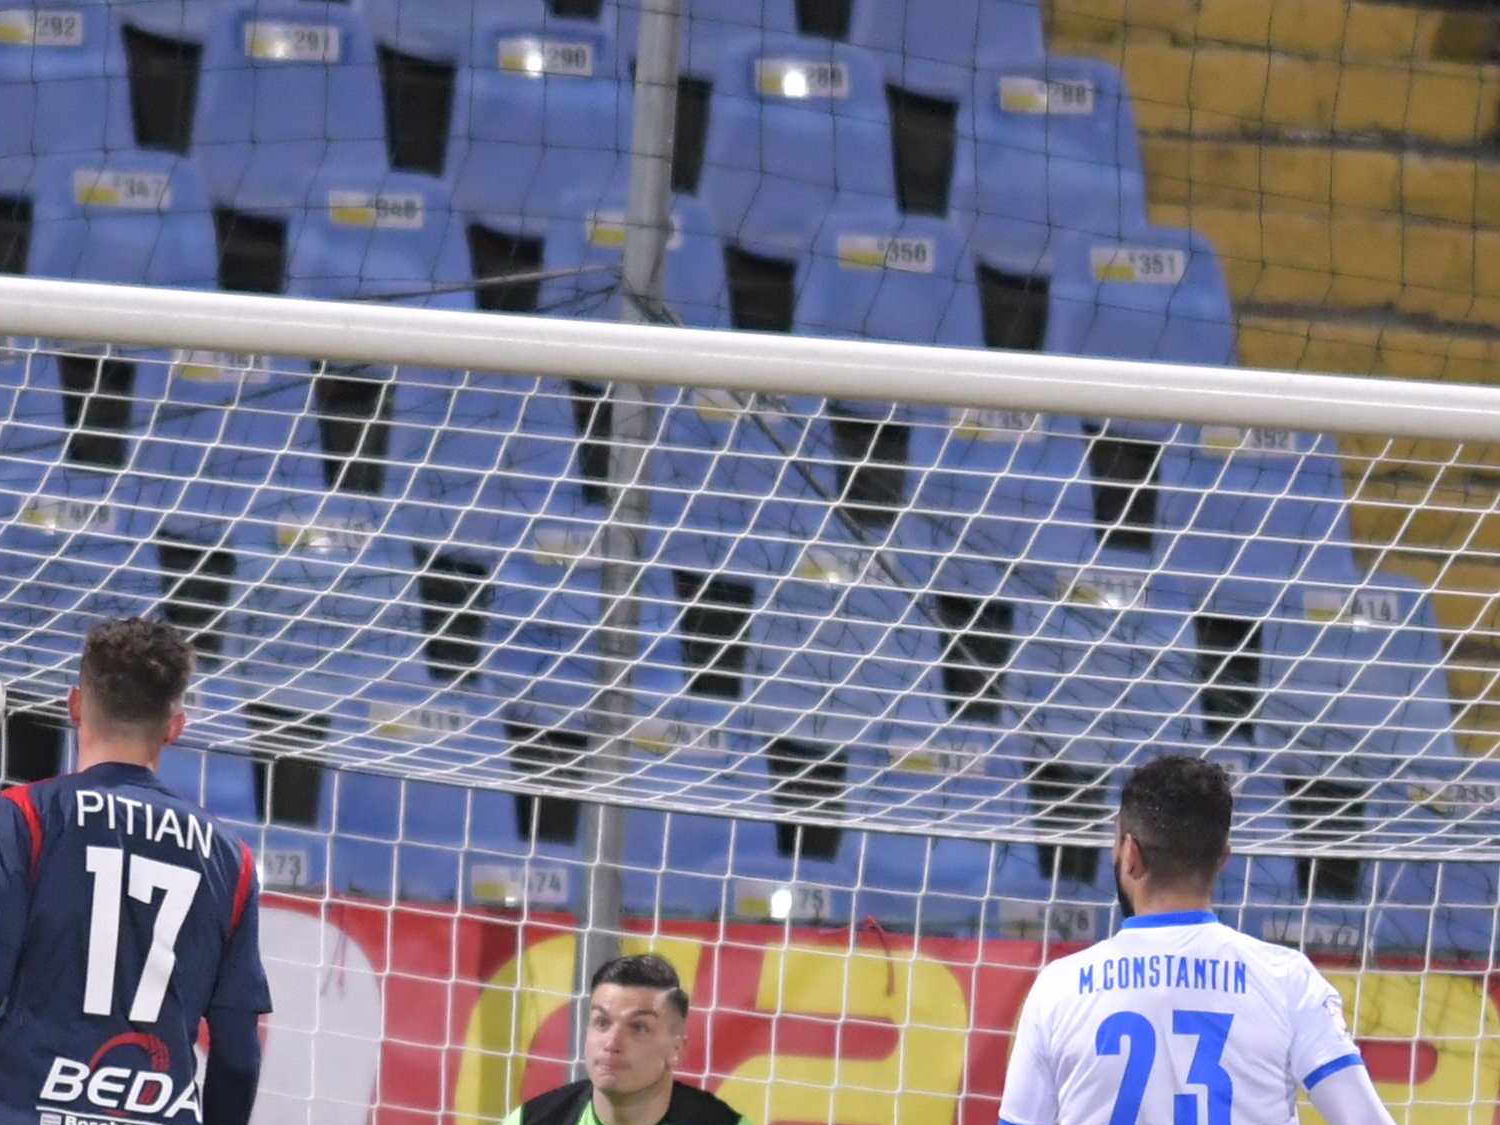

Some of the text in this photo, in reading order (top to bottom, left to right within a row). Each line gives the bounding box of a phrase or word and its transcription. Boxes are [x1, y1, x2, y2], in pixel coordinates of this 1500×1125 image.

[38, 16, 77, 37] 292
[888, 241, 928, 264] 350
[1138, 253, 1177, 275] 351
[75, 790, 213, 859] PITIAN
[83, 845, 202, 1023] 17
[1078, 953, 1247, 995] M.CONSTANTIN
[39, 1056, 203, 1124] BEDA
